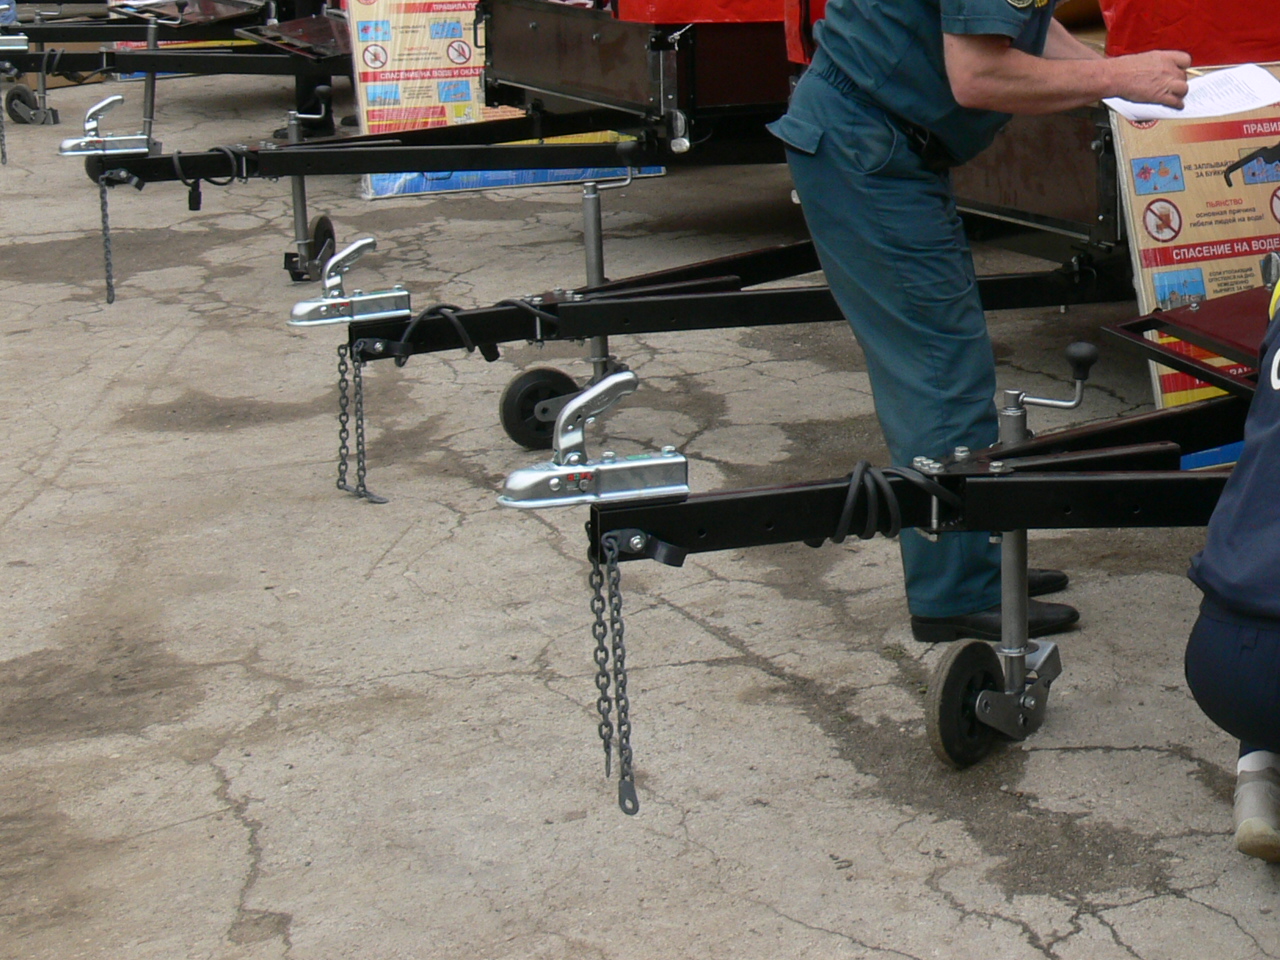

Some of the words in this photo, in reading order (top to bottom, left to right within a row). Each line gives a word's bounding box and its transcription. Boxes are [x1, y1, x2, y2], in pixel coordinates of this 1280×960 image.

[433, 2, 466, 11] ПРАВИЛА
[380, 71, 420, 80] СПАСЕНИЕ
[460, 68, 485, 76] ОКАЗА
[1205, 168, 1226, 177] БУЙКИ
[1206, 198, 1243, 209] ПЬЯНСТВО
[1196, 210, 1227, 219] основная
[1229, 207, 1256, 217] причина
[1190, 219, 1213, 229] гибели
[1247, 213, 1265, 223] воде!
[1173, 245, 1232, 261] СПАСЕНИЕ
[1235, 242, 1250, 253] НА
[1252, 239, 1280, 252] ВОДЕ
